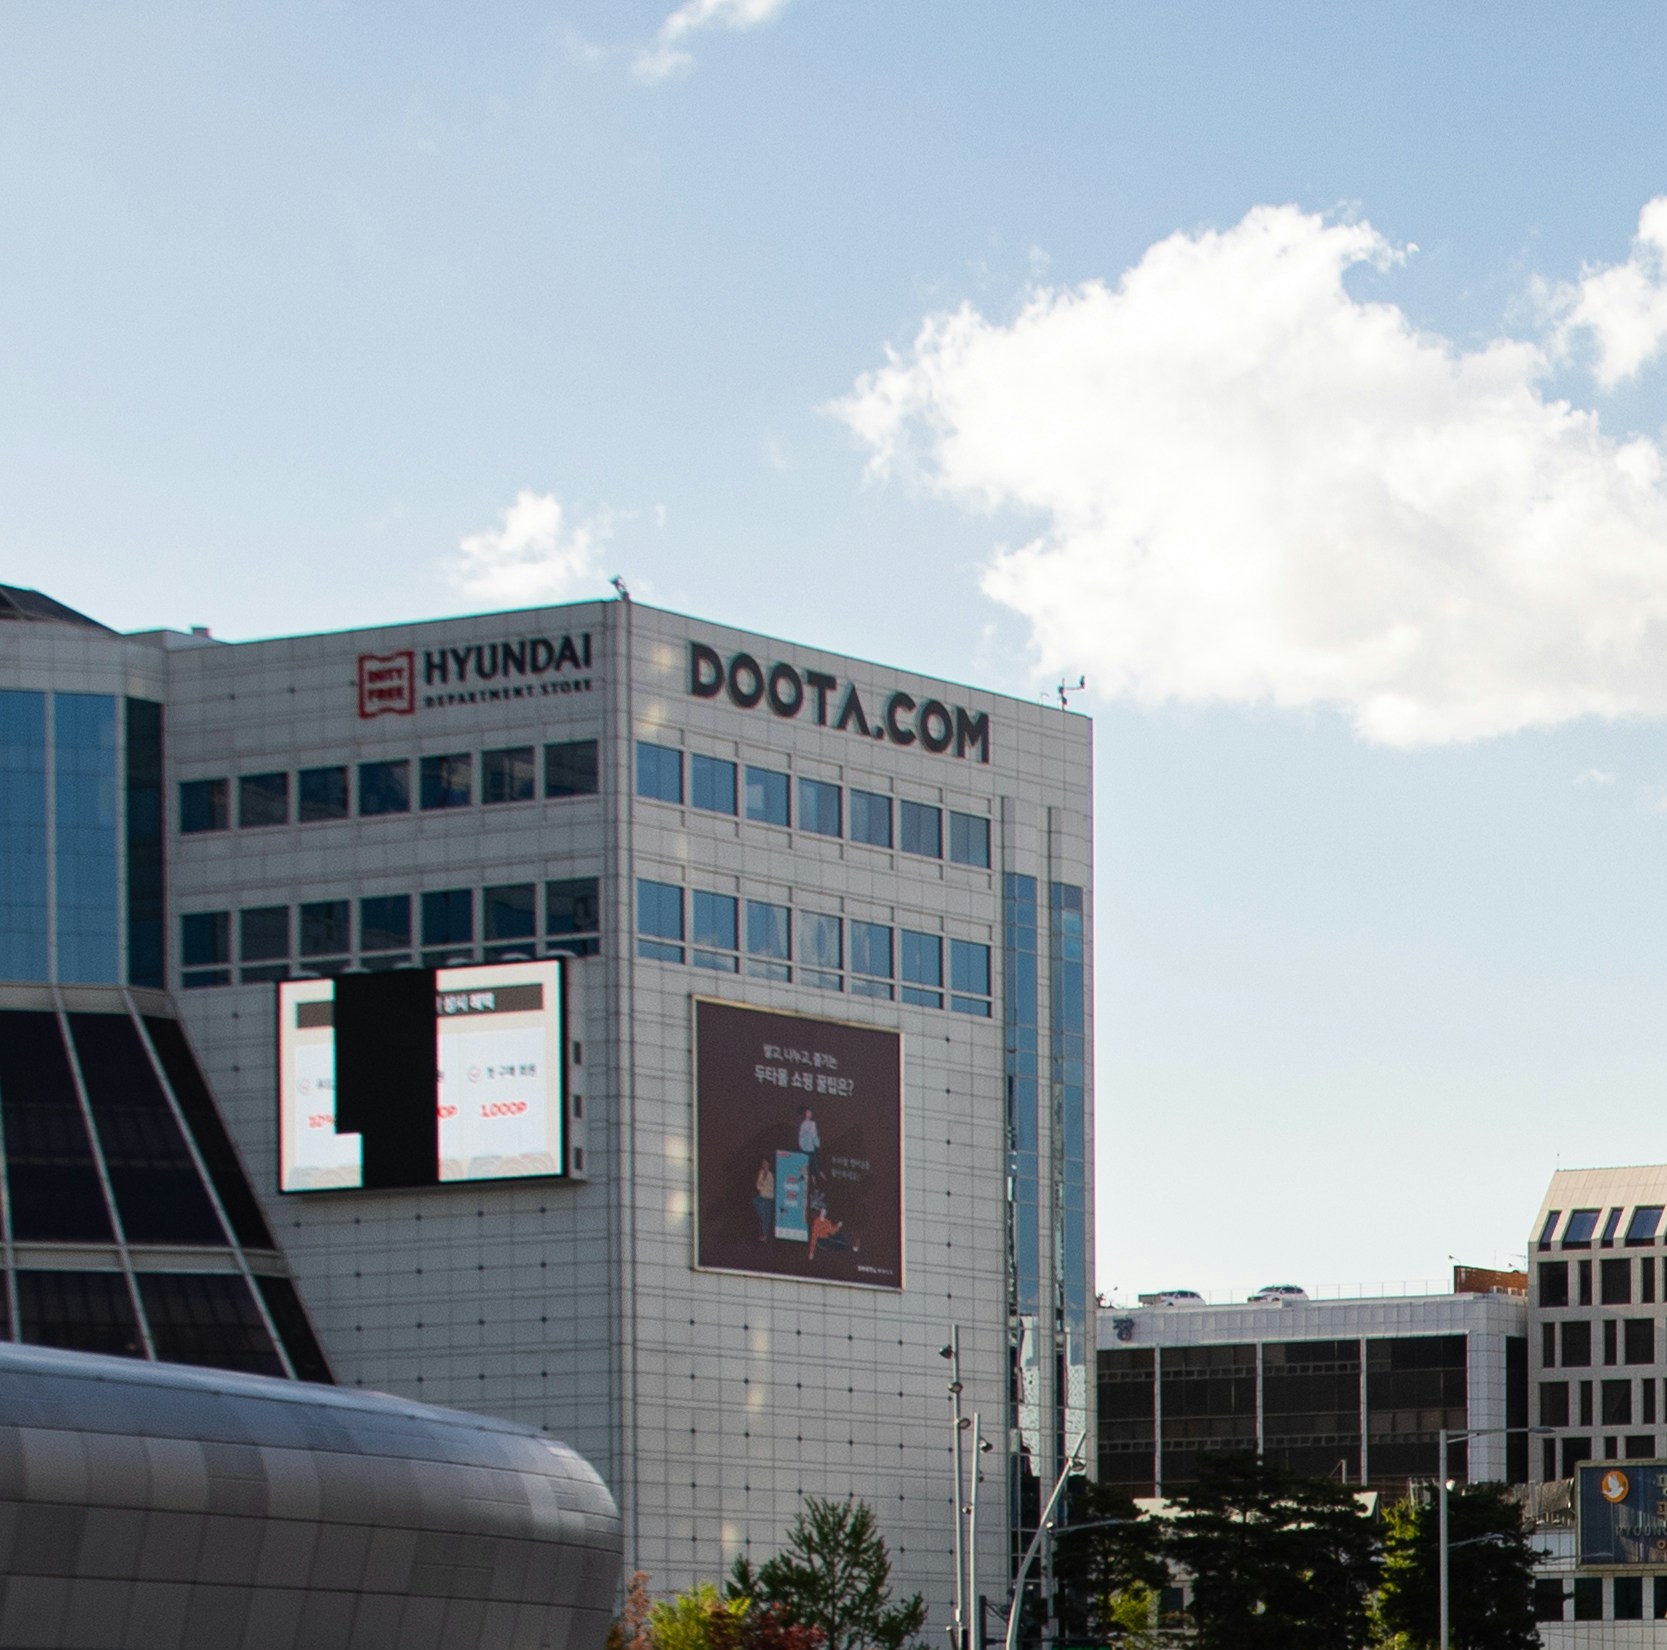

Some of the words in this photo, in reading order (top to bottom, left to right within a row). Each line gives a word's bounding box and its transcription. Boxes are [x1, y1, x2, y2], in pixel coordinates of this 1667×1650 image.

[424, 633, 592, 685] HYUNDAI
[368, 667, 405, 683] DUTY
[368, 686, 405, 702] FREE
[424, 684, 535, 708] DEPARTMENT
[540, 679, 592, 697] STORE
[688, 641, 989, 763] DOOTA.COM
[754, 1064, 788, 1088] 두타몰
[791, 1071, 814, 1091] 쇼핑
